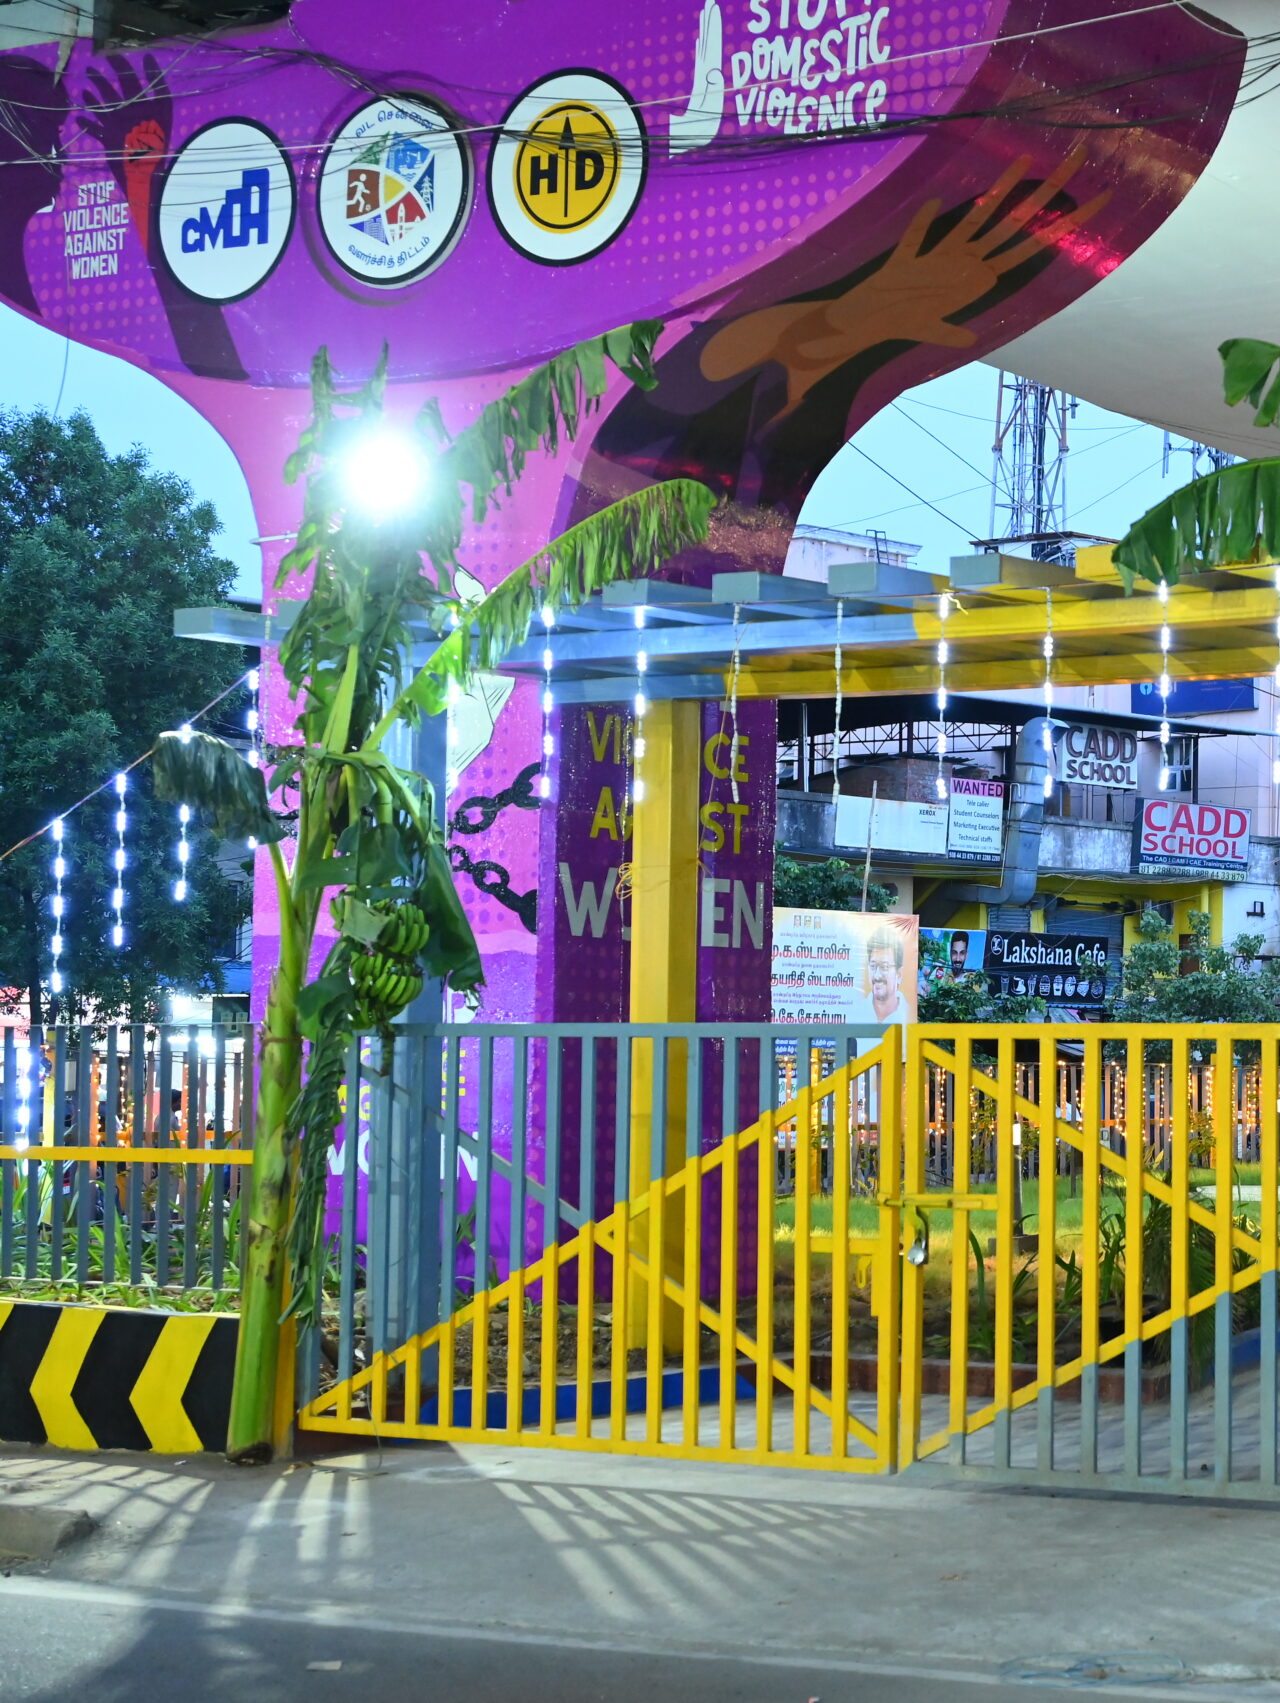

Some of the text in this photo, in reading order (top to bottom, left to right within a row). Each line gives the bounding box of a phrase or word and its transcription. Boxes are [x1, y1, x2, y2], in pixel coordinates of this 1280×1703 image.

[77, 180, 116, 207] STOP
[63, 202, 130, 232] VIOLENCE
[64, 228, 127, 257] AGAINST
[71, 253, 118, 280] WOMEN
[1065, 725, 1137, 764] CADD
[1066, 759, 1137, 786] SCHOOL
[953, 779, 1003, 797] WANTED
[953, 808, 1000, 820] Student Counselors
[953, 821, 977, 831] Marketing
[978, 823, 1000, 832] Executive
[1144, 800, 1248, 838] CADD
[1142, 832, 1244, 860] SCHOOL
[1203, 860, 1225, 869] Training
[1003, 939, 1072, 965] Lakshana
